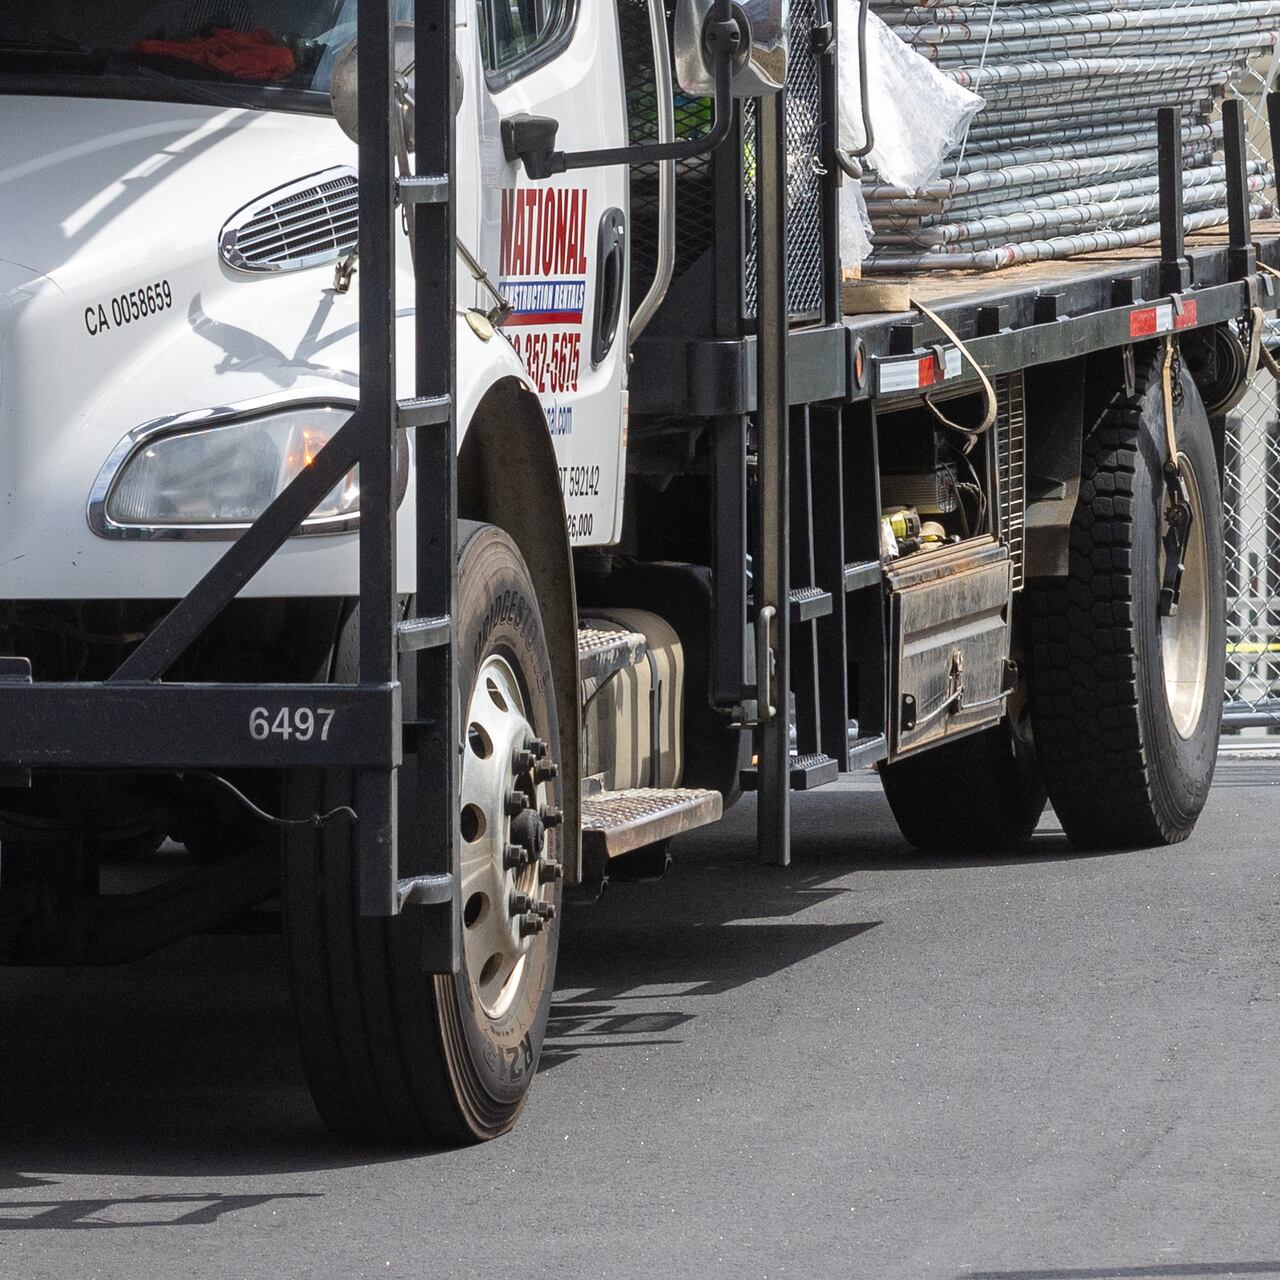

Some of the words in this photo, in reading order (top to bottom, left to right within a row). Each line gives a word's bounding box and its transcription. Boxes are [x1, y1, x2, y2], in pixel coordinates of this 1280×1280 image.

[498, 187, 589, 277] NATIONAL
[84, 303, 110, 336] CA
[111, 279, 173, 327] 0058659
[553, 283, 585, 310] RENTALS
[569, 465, 600, 496] 592142
[248, 706, 336, 741] 6497
